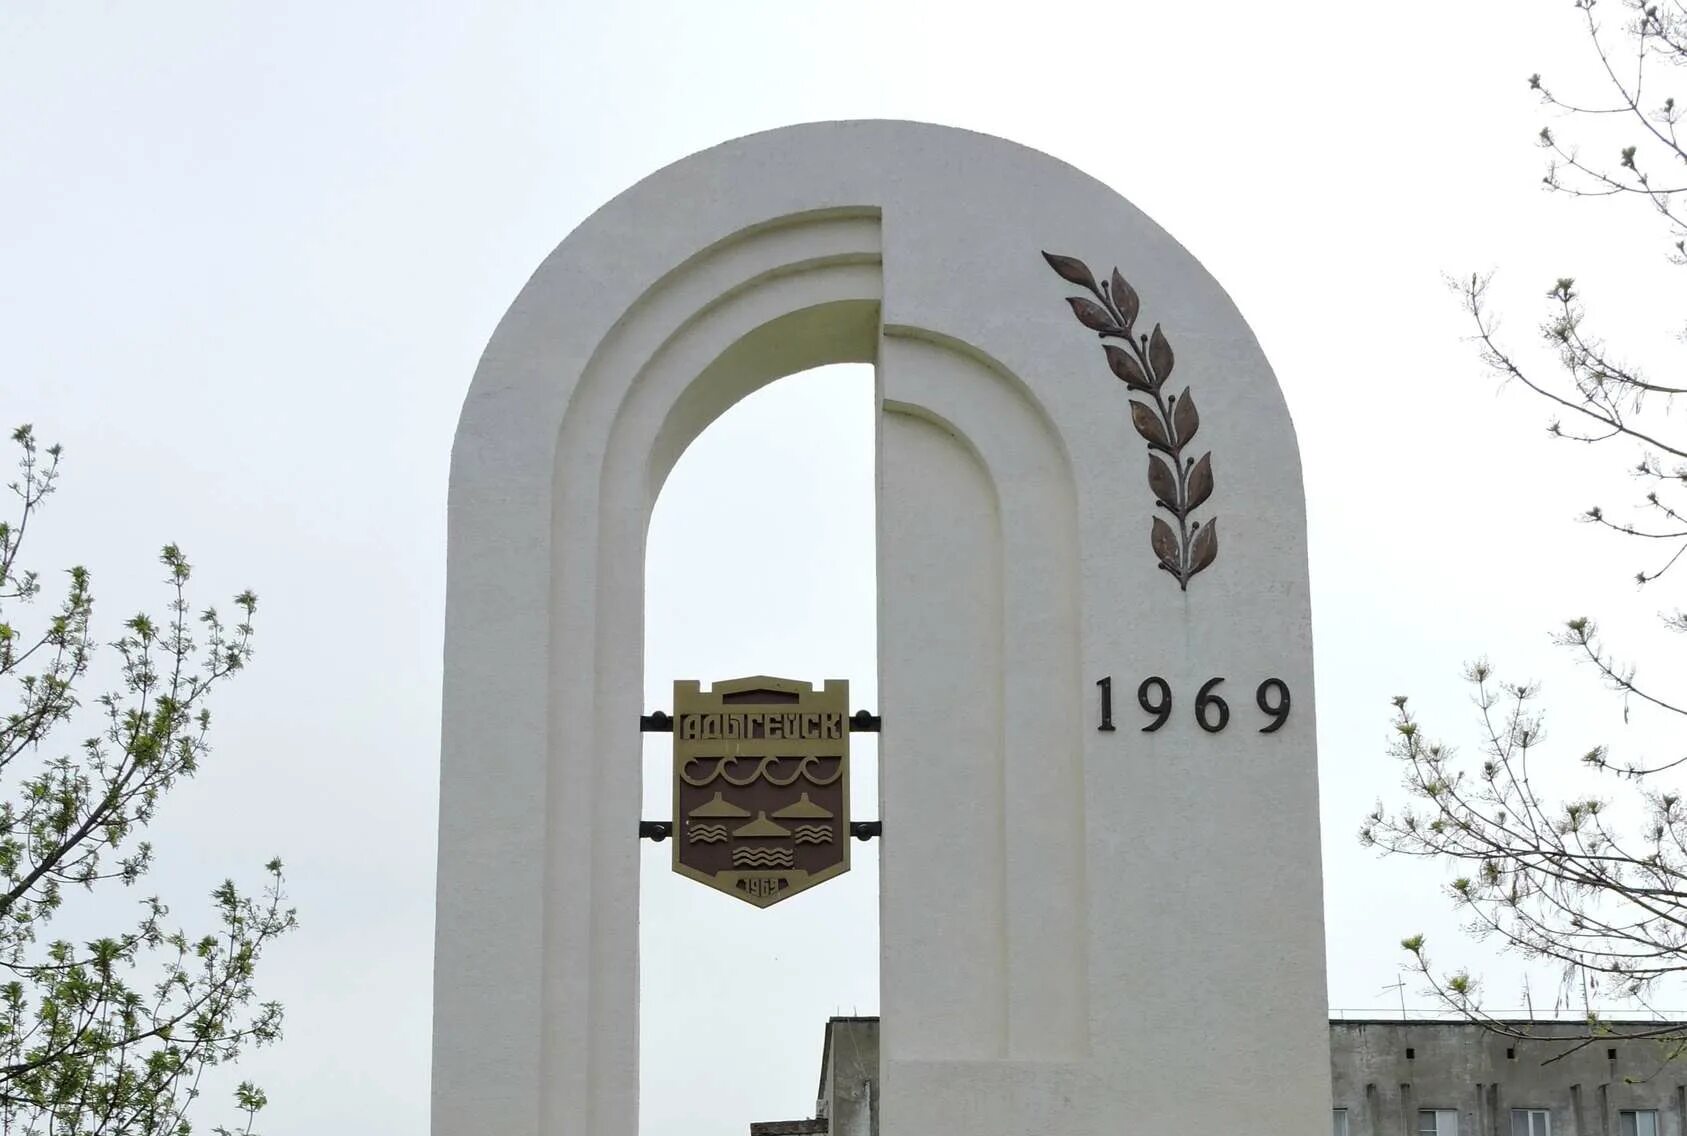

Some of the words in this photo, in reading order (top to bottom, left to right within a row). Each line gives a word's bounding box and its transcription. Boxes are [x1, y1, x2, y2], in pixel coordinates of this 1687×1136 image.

[1096, 676, 1291, 733] 1969
[682, 713, 842, 740] АДЫГЕЙСК
[744, 878, 779, 897] 1969
